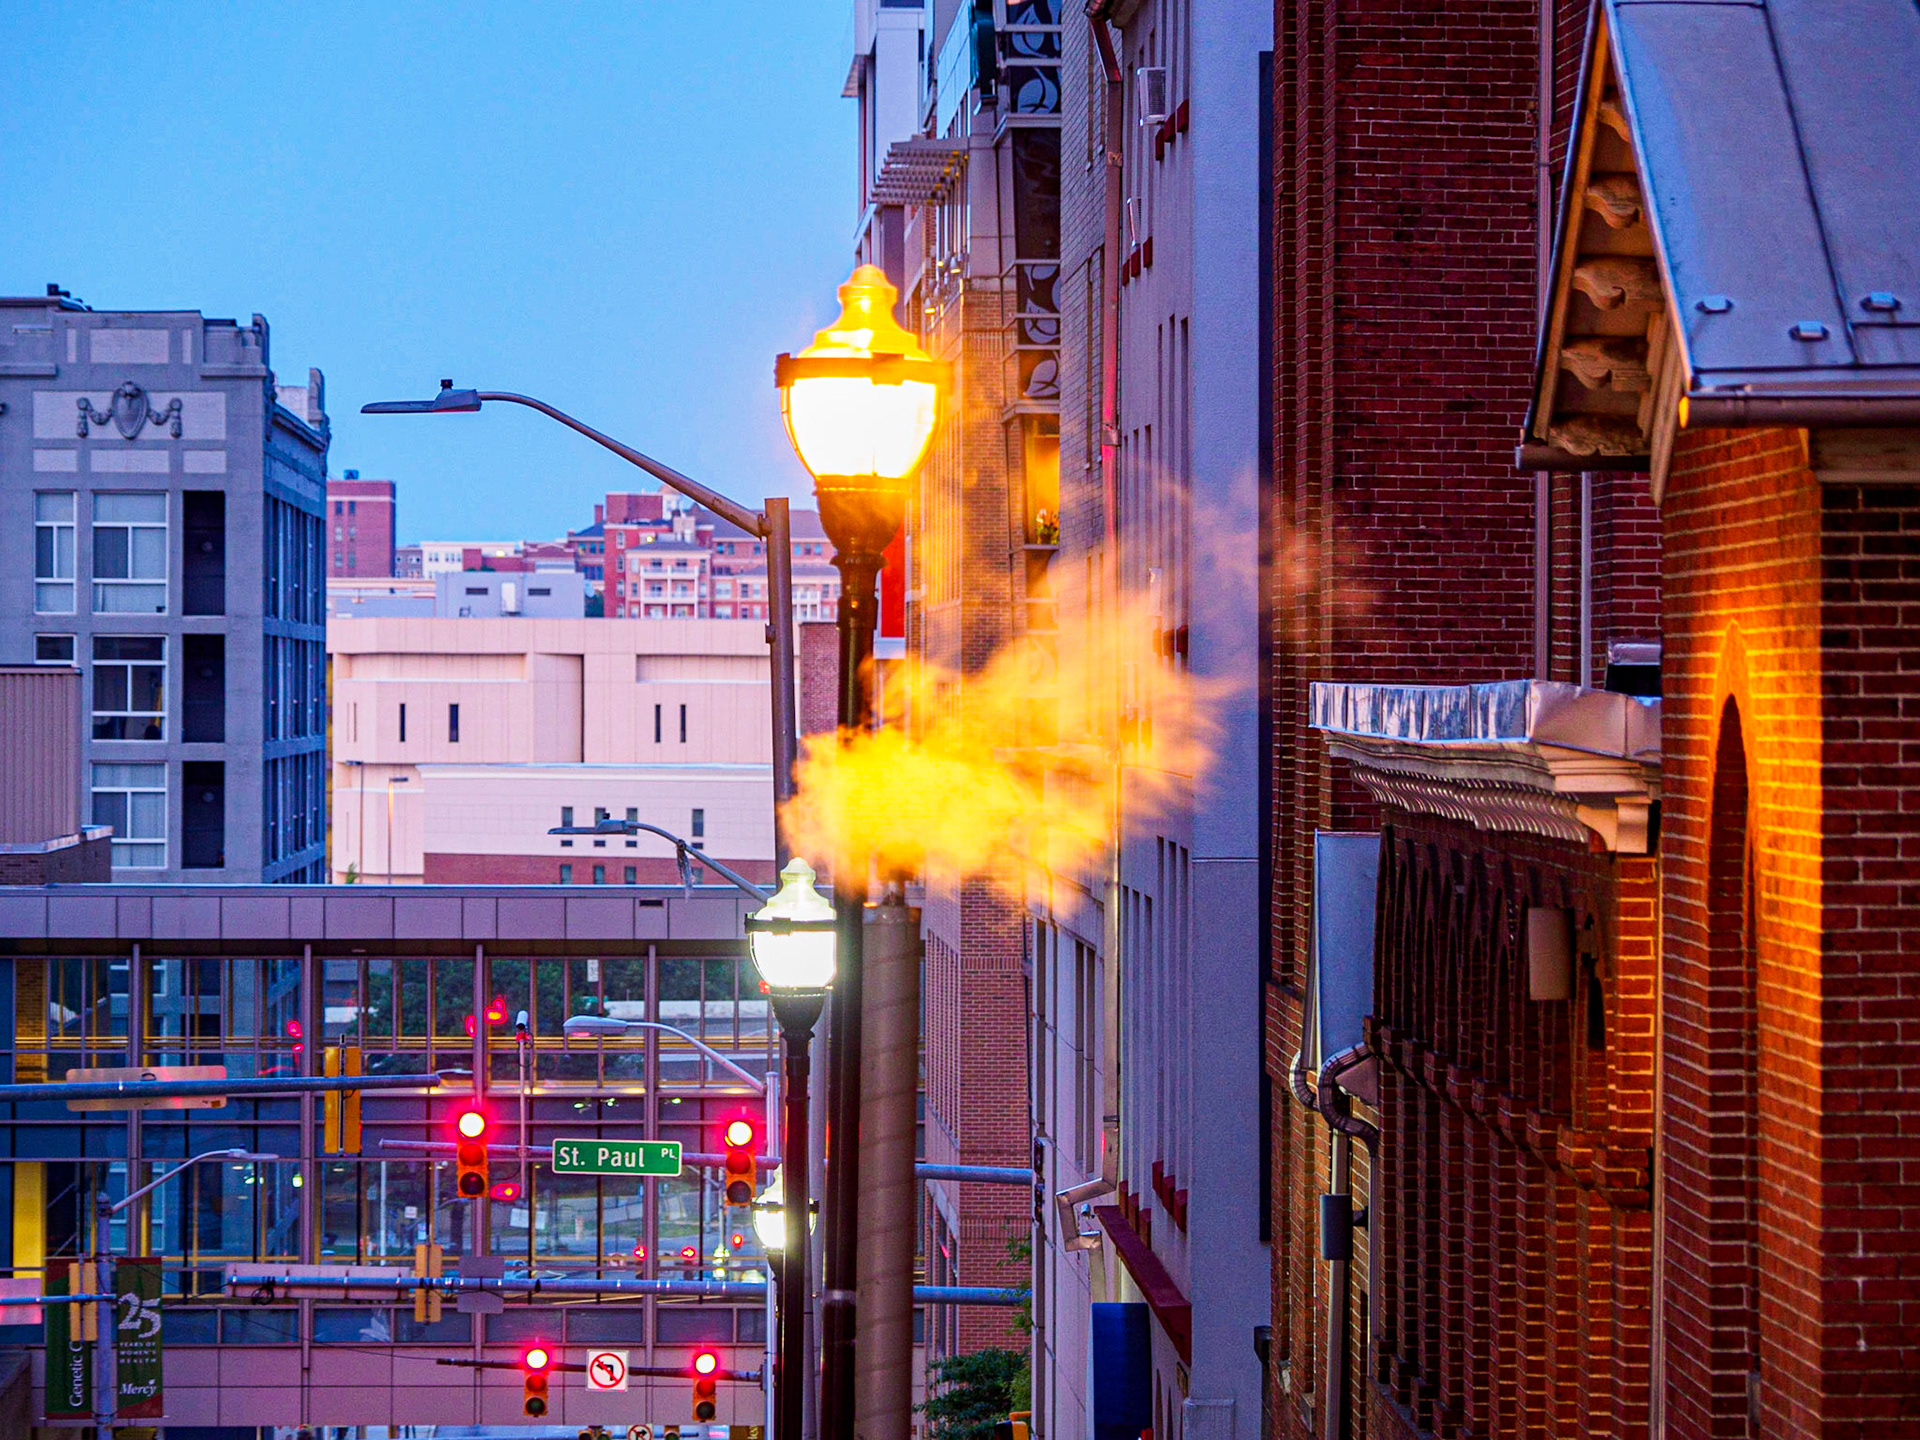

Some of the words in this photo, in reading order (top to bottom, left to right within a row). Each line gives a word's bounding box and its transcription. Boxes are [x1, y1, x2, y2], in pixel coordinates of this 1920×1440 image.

[559, 1146, 585, 1166] St.
[598, 1147, 644, 1167] Paul
[118, 1292, 161, 1338] 25
[69, 1351, 83, 1407] Genetic
[119, 1381, 157, 1397] Mercy
